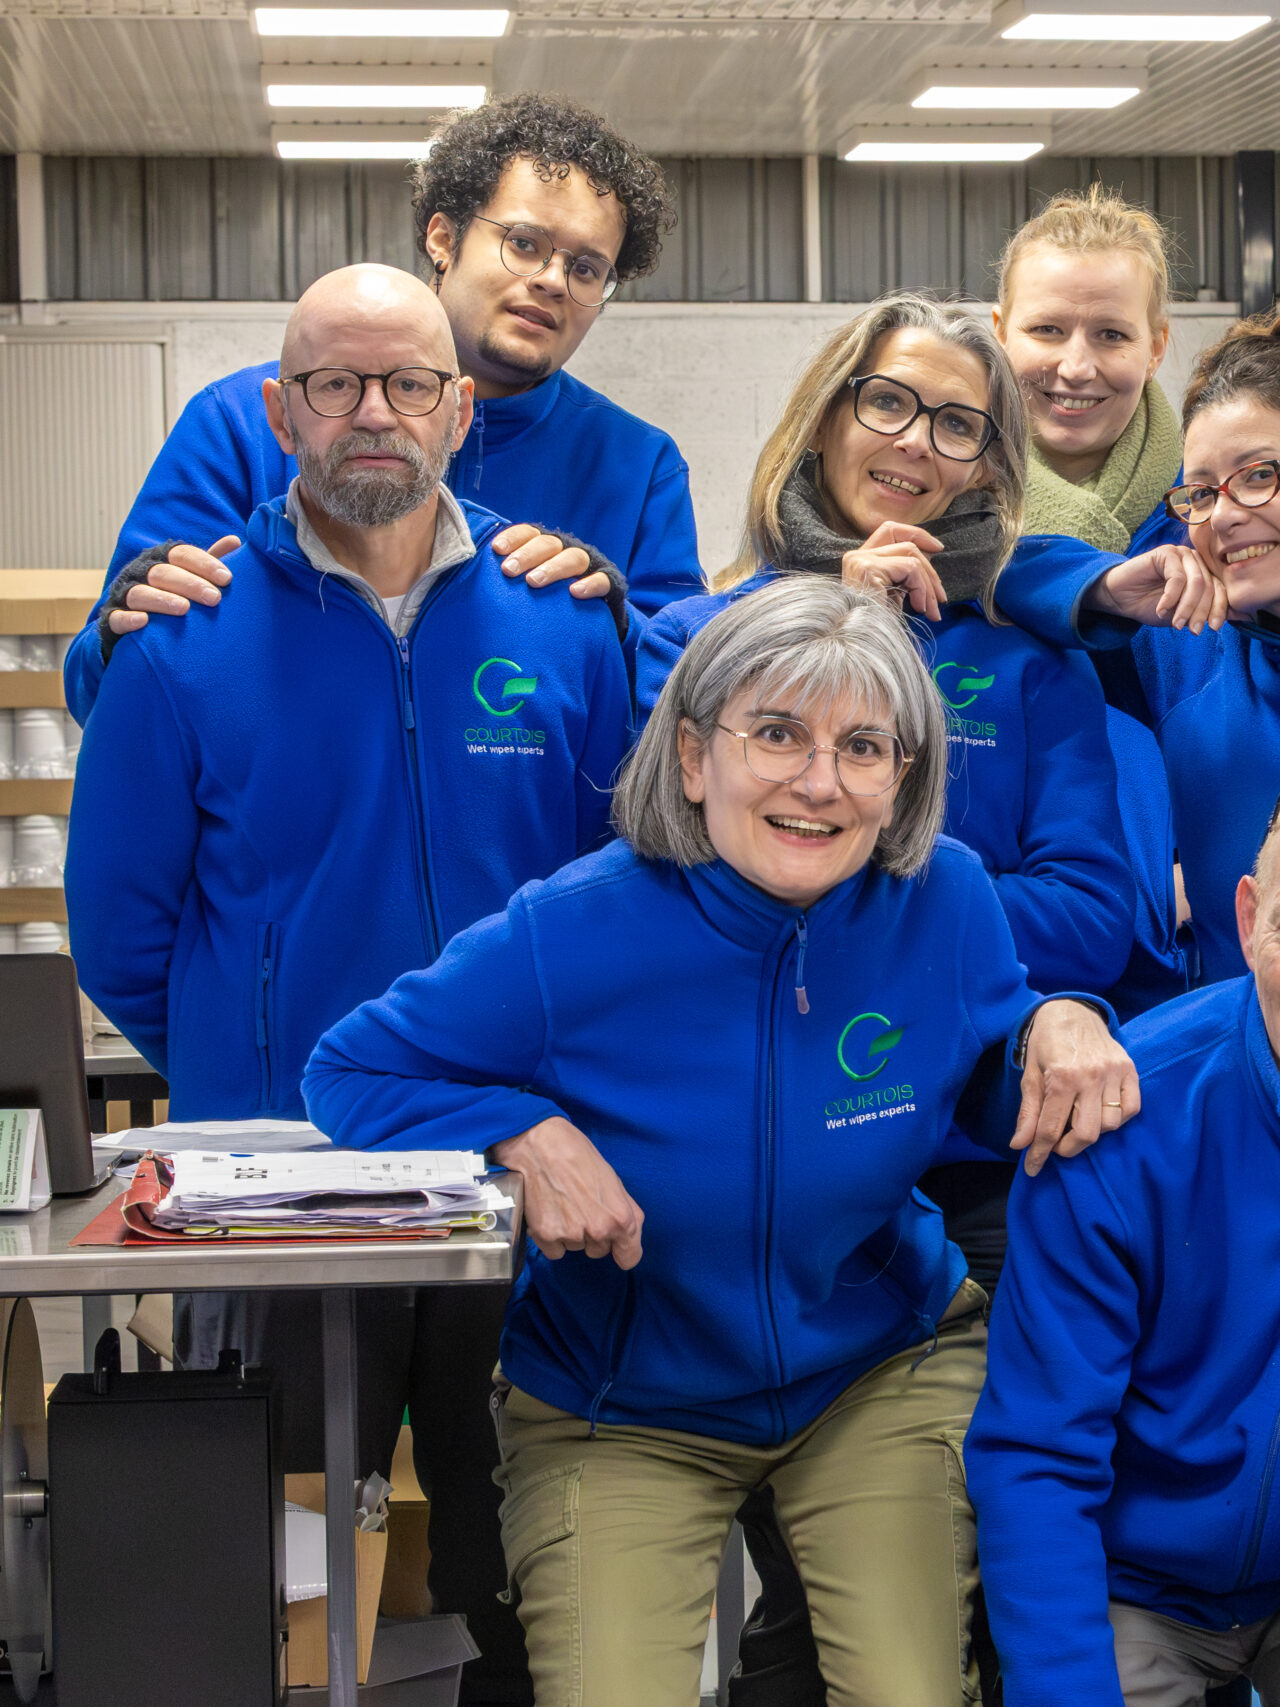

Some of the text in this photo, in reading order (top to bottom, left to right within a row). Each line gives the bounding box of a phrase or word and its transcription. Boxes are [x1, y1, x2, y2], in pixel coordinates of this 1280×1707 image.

[464, 727, 546, 743] COURTOIS
[467, 744, 487, 754] Wet
[489, 746, 515, 755] wipes
[825, 1084, 914, 1116] COURTOIS
[826, 1102, 916, 1130] Wet wipes experts
